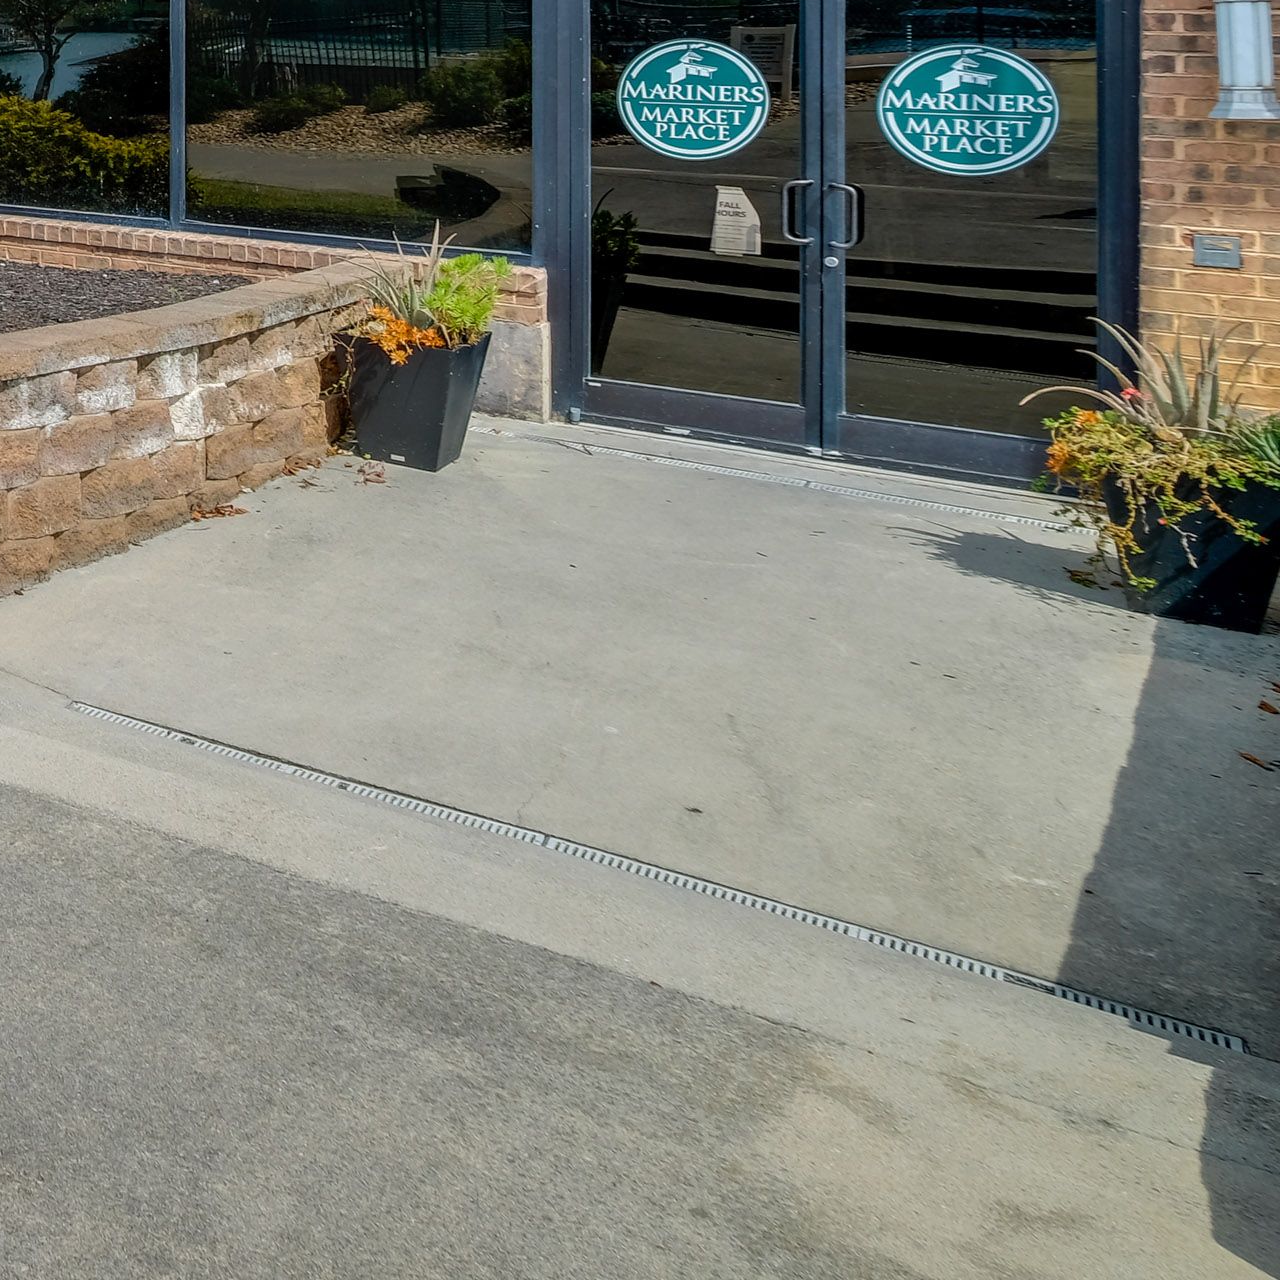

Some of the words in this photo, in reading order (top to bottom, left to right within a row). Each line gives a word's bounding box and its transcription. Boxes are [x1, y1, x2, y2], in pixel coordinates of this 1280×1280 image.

[622, 80, 765, 103] MARINERS
[882, 88, 1053, 113] MARINERS
[640, 107, 746, 126] MARKET
[654, 122, 731, 141] PLACE
[904, 117, 1031, 138] MARKET
[922, 134, 1014, 155] PLACE
[715, 210, 747, 218] HOURS
[719, 201, 742, 209] FALL
